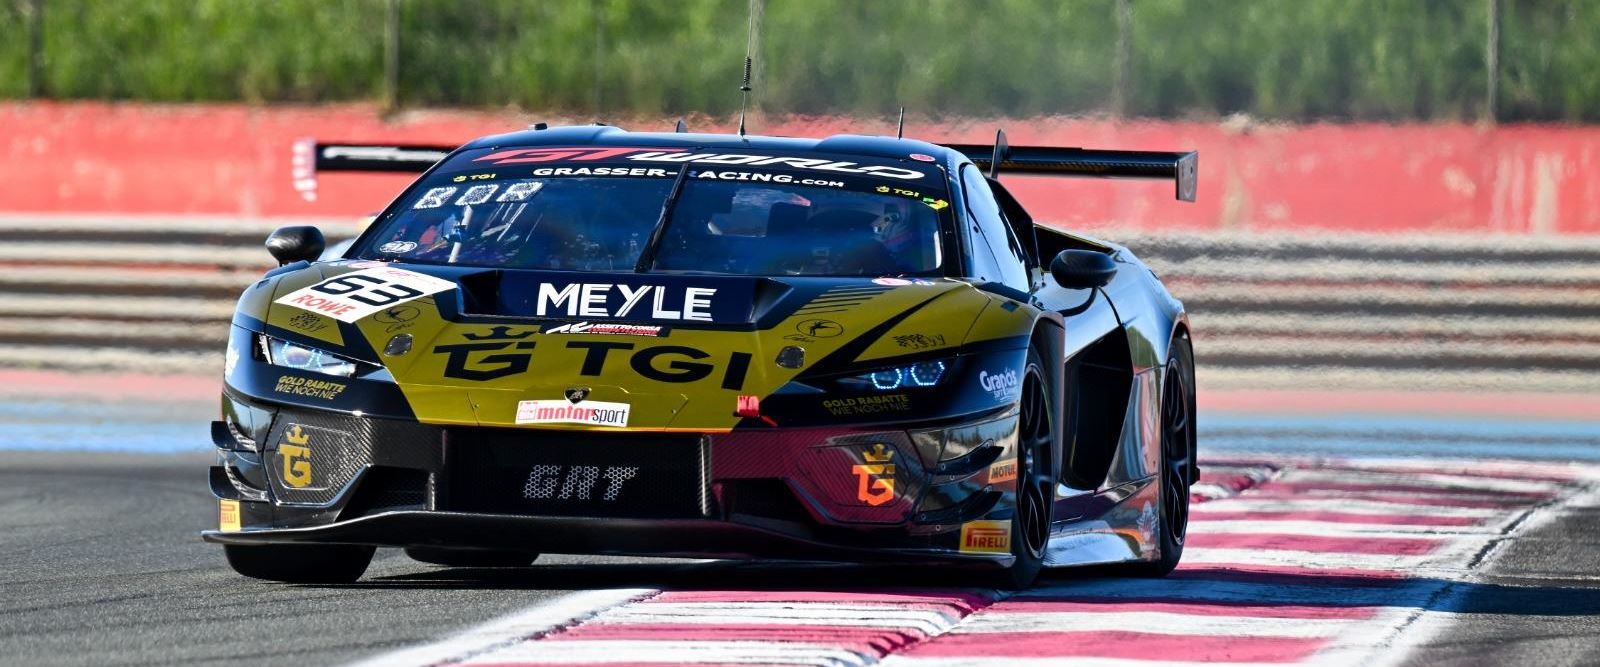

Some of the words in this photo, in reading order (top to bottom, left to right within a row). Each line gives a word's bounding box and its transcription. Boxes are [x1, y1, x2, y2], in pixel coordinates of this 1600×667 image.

[626, 151, 925, 180] WORLD
[893, 188, 920, 198] TGI
[310, 274, 425, 307] 63
[293, 294, 357, 318] ROWE
[536, 282, 718, 322] MEYLE
[565, 341, 753, 391] TGI
[275, 383, 294, 393] WIE
[291, 385, 321, 397] NOCH
[319, 389, 338, 400] NIE
[279, 375, 305, 386] GOLD
[304, 379, 347, 393] RABATTE
[823, 398, 857, 408] GOLD
[857, 394, 908, 405] RABATTE
[831, 407, 853, 416] WIE
[854, 403, 889, 414] NOCH
[522, 464, 639, 500] GRT
[991, 464, 1016, 479] MOTUL
[966, 527, 1009, 548] PIRELLI
